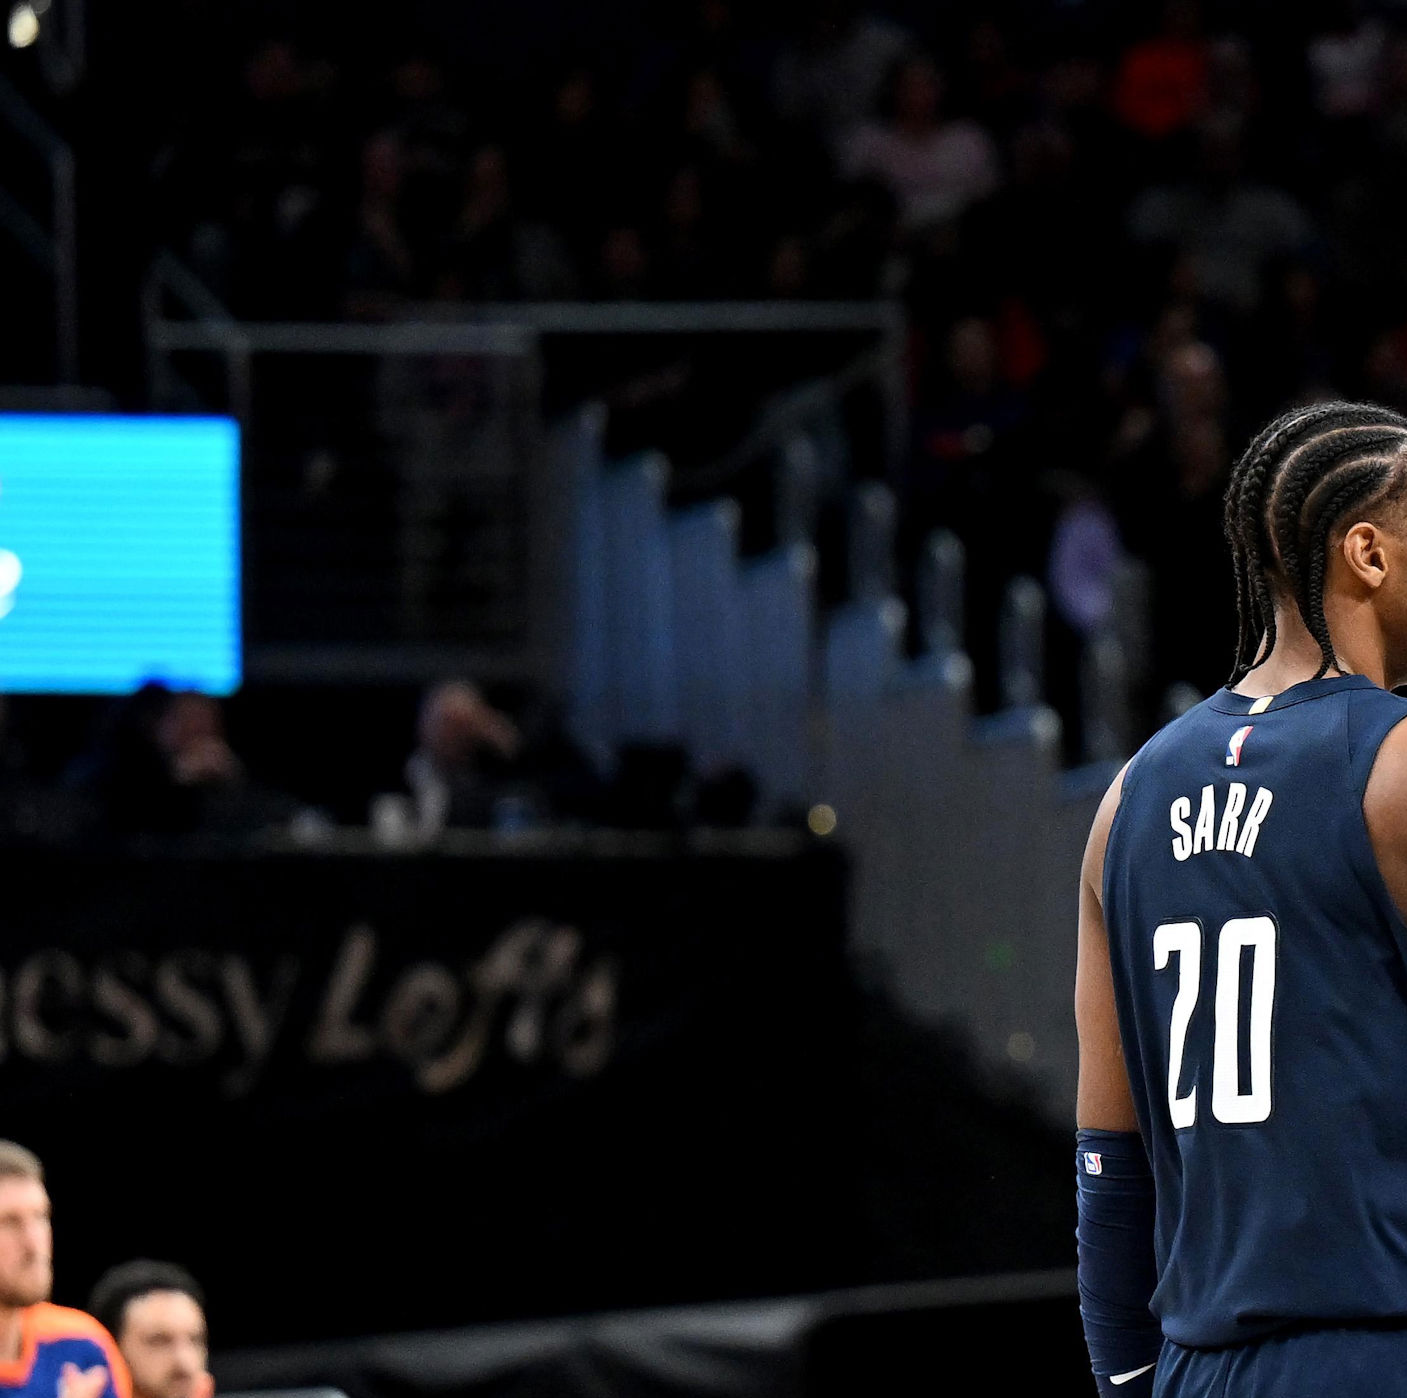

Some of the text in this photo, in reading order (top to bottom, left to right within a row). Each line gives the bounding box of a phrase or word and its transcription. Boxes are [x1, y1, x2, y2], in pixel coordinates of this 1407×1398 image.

[1170, 782, 1273, 862] SARR
[0, 948, 300, 1098] essy
[1153, 916, 1277, 1130] 20
